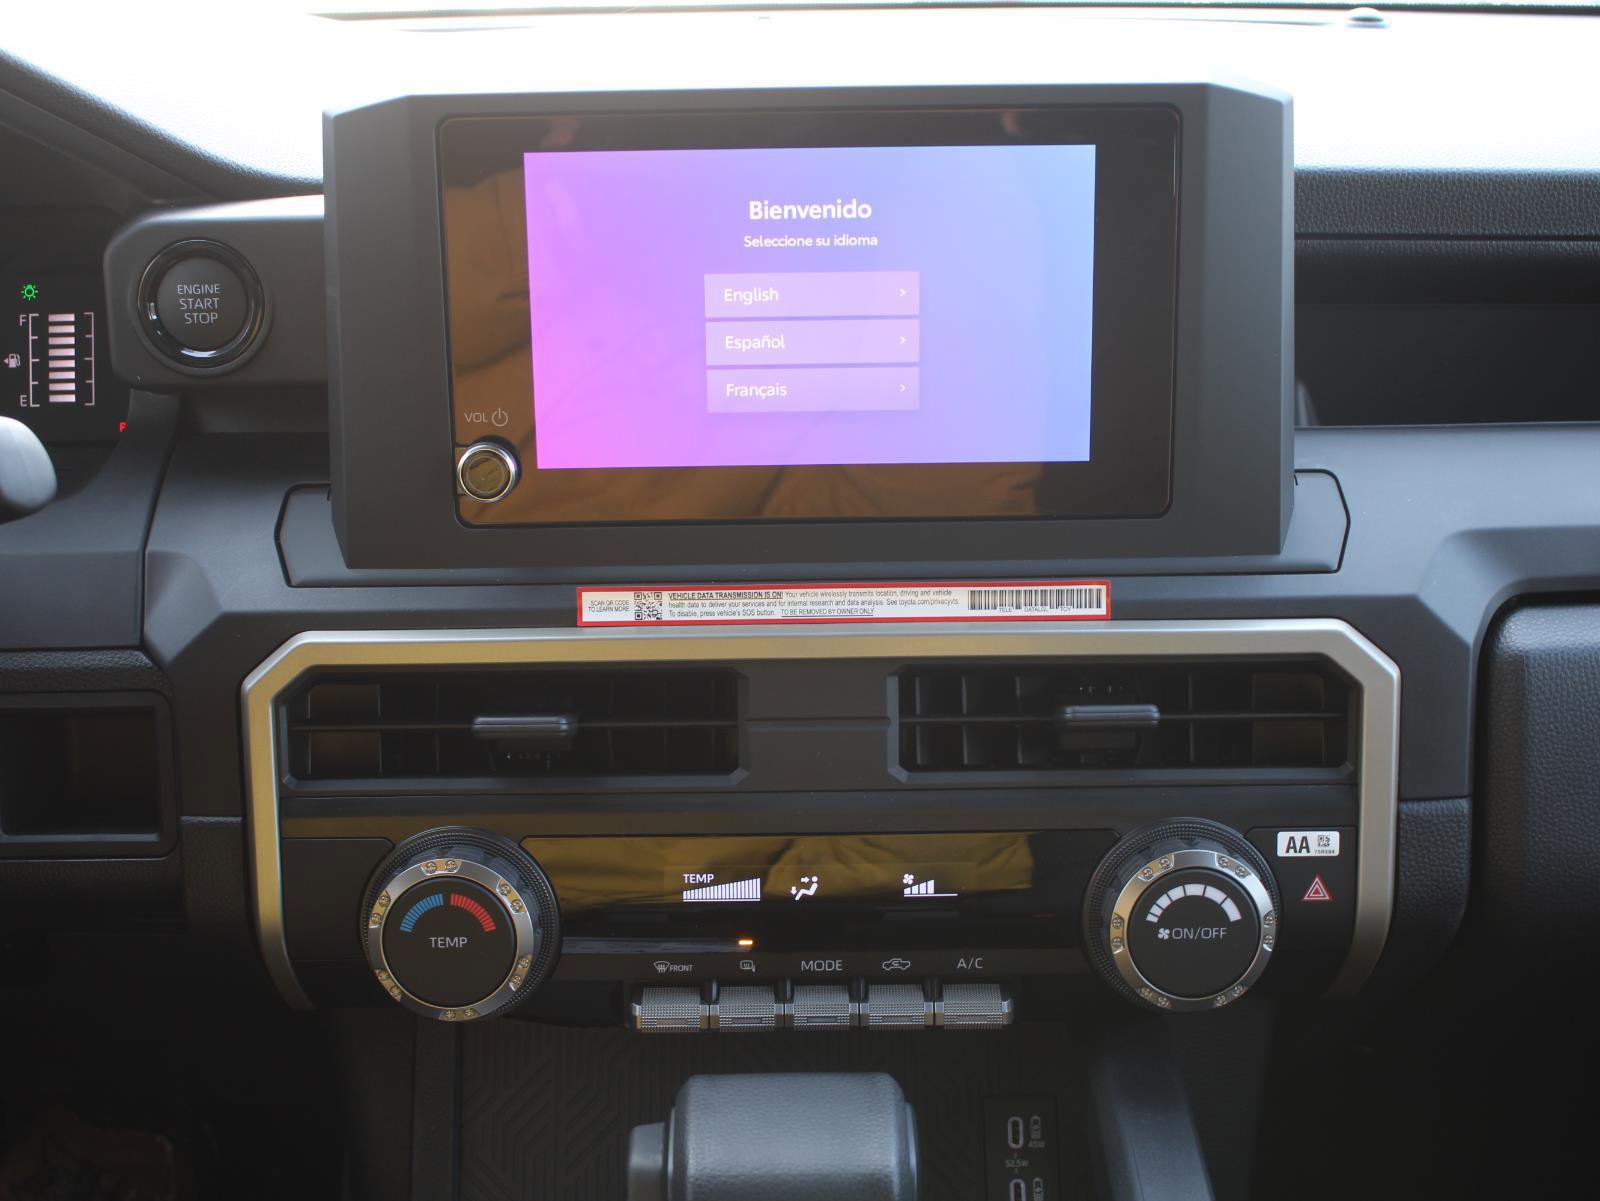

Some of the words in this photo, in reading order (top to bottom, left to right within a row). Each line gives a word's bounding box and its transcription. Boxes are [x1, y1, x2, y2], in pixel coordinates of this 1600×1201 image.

[749, 199, 873, 220] Bienvenido
[743, 235, 813, 248] Seleccione
[815, 236, 831, 247] su
[833, 234, 879, 247] idioma
[177, 284, 221, 294] ENGINE
[724, 288, 779, 305] English
[179, 298, 220, 310] START
[19, 314, 27, 326] F
[184, 312, 219, 325] STOP
[725, 334, 786, 352] Español
[726, 382, 788, 400] Français
[20, 395, 28, 407] E
[464, 412, 488, 423] VOL
[668, 592, 695, 600] VEHICLE
[697, 592, 713, 600] DATA
[715, 591, 763, 600] TRANSMISSION
[764, 591, 770, 599] IS
[772, 591, 784, 599] ON!
[900, 590, 919, 598] driving
[781, 608, 789, 616] TO
[790, 608, 798, 616] BE
[1285, 836, 1311, 854] AA
[683, 873, 714, 883] TEMP
[1172, 927, 1227, 940] ON/OFF
[429, 937, 468, 948] TEMP
[669, 964, 693, 973] FRONT
[801, 960, 843, 972] MODE
[957, 957, 983, 970] A/C
